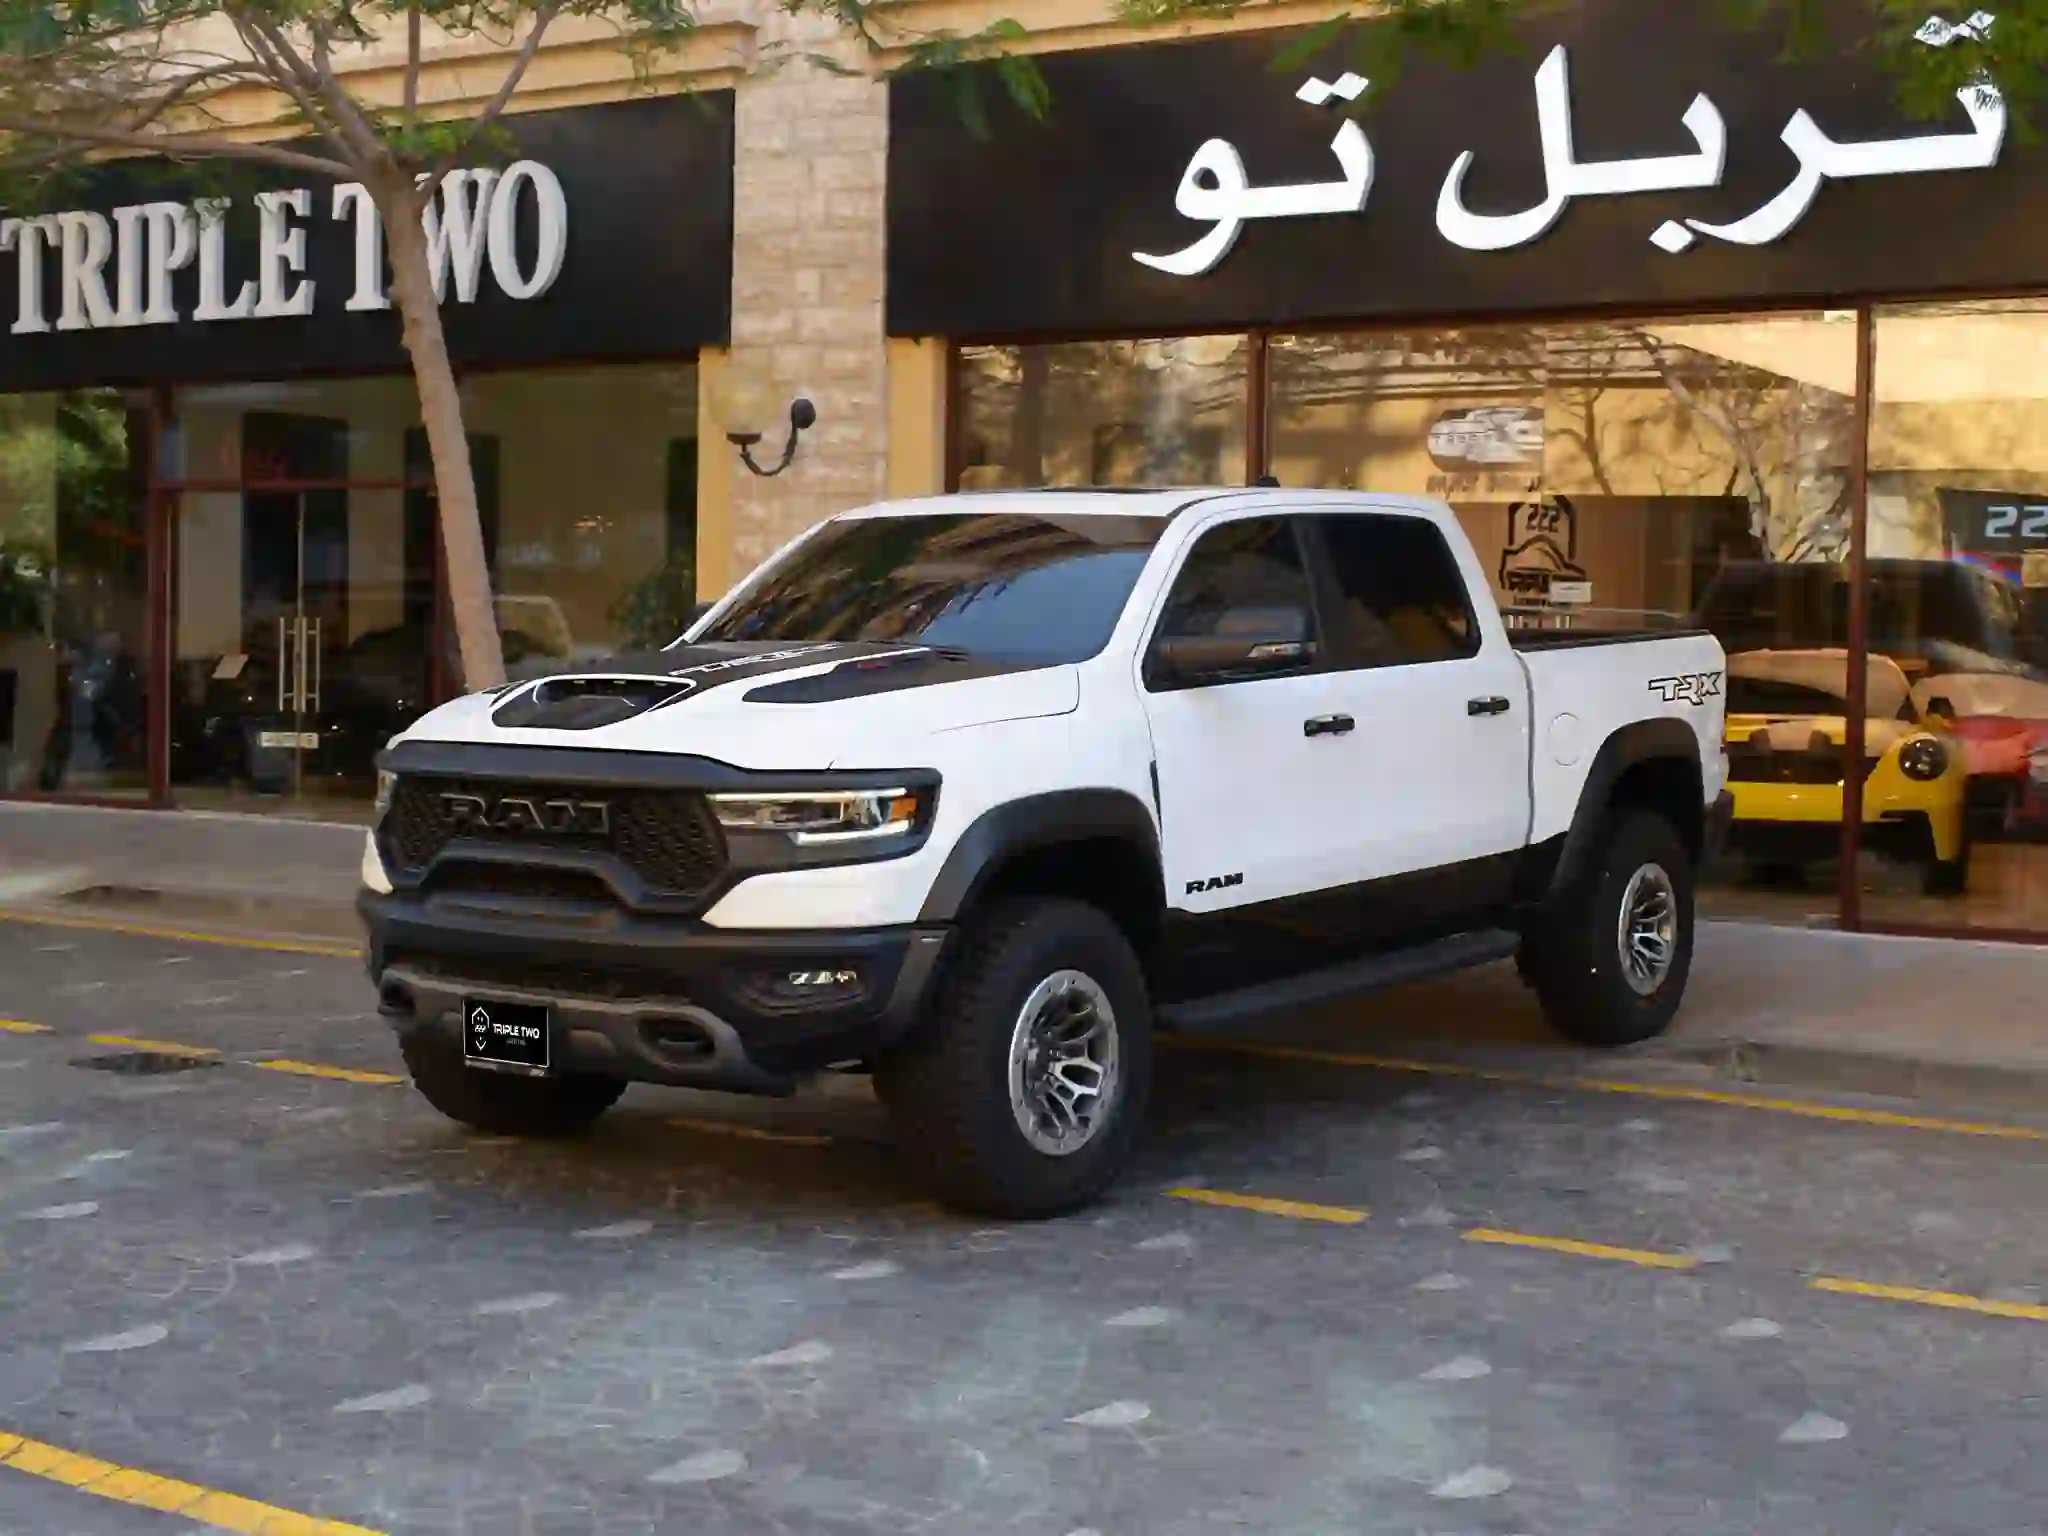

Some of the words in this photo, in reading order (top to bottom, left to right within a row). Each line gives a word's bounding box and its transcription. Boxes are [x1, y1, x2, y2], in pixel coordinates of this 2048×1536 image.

[1131, 71, 1376, 275] تو
[0, 189, 317, 334] TRIPLE
[332, 159, 568, 311] TWO
[1648, 671, 1722, 706] TRX
[438, 792, 610, 835] RAM
[1186, 872, 1243, 895] RAM
[492, 1023, 519, 1037] TRIPLE
[520, 1026, 541, 1040] TWO
